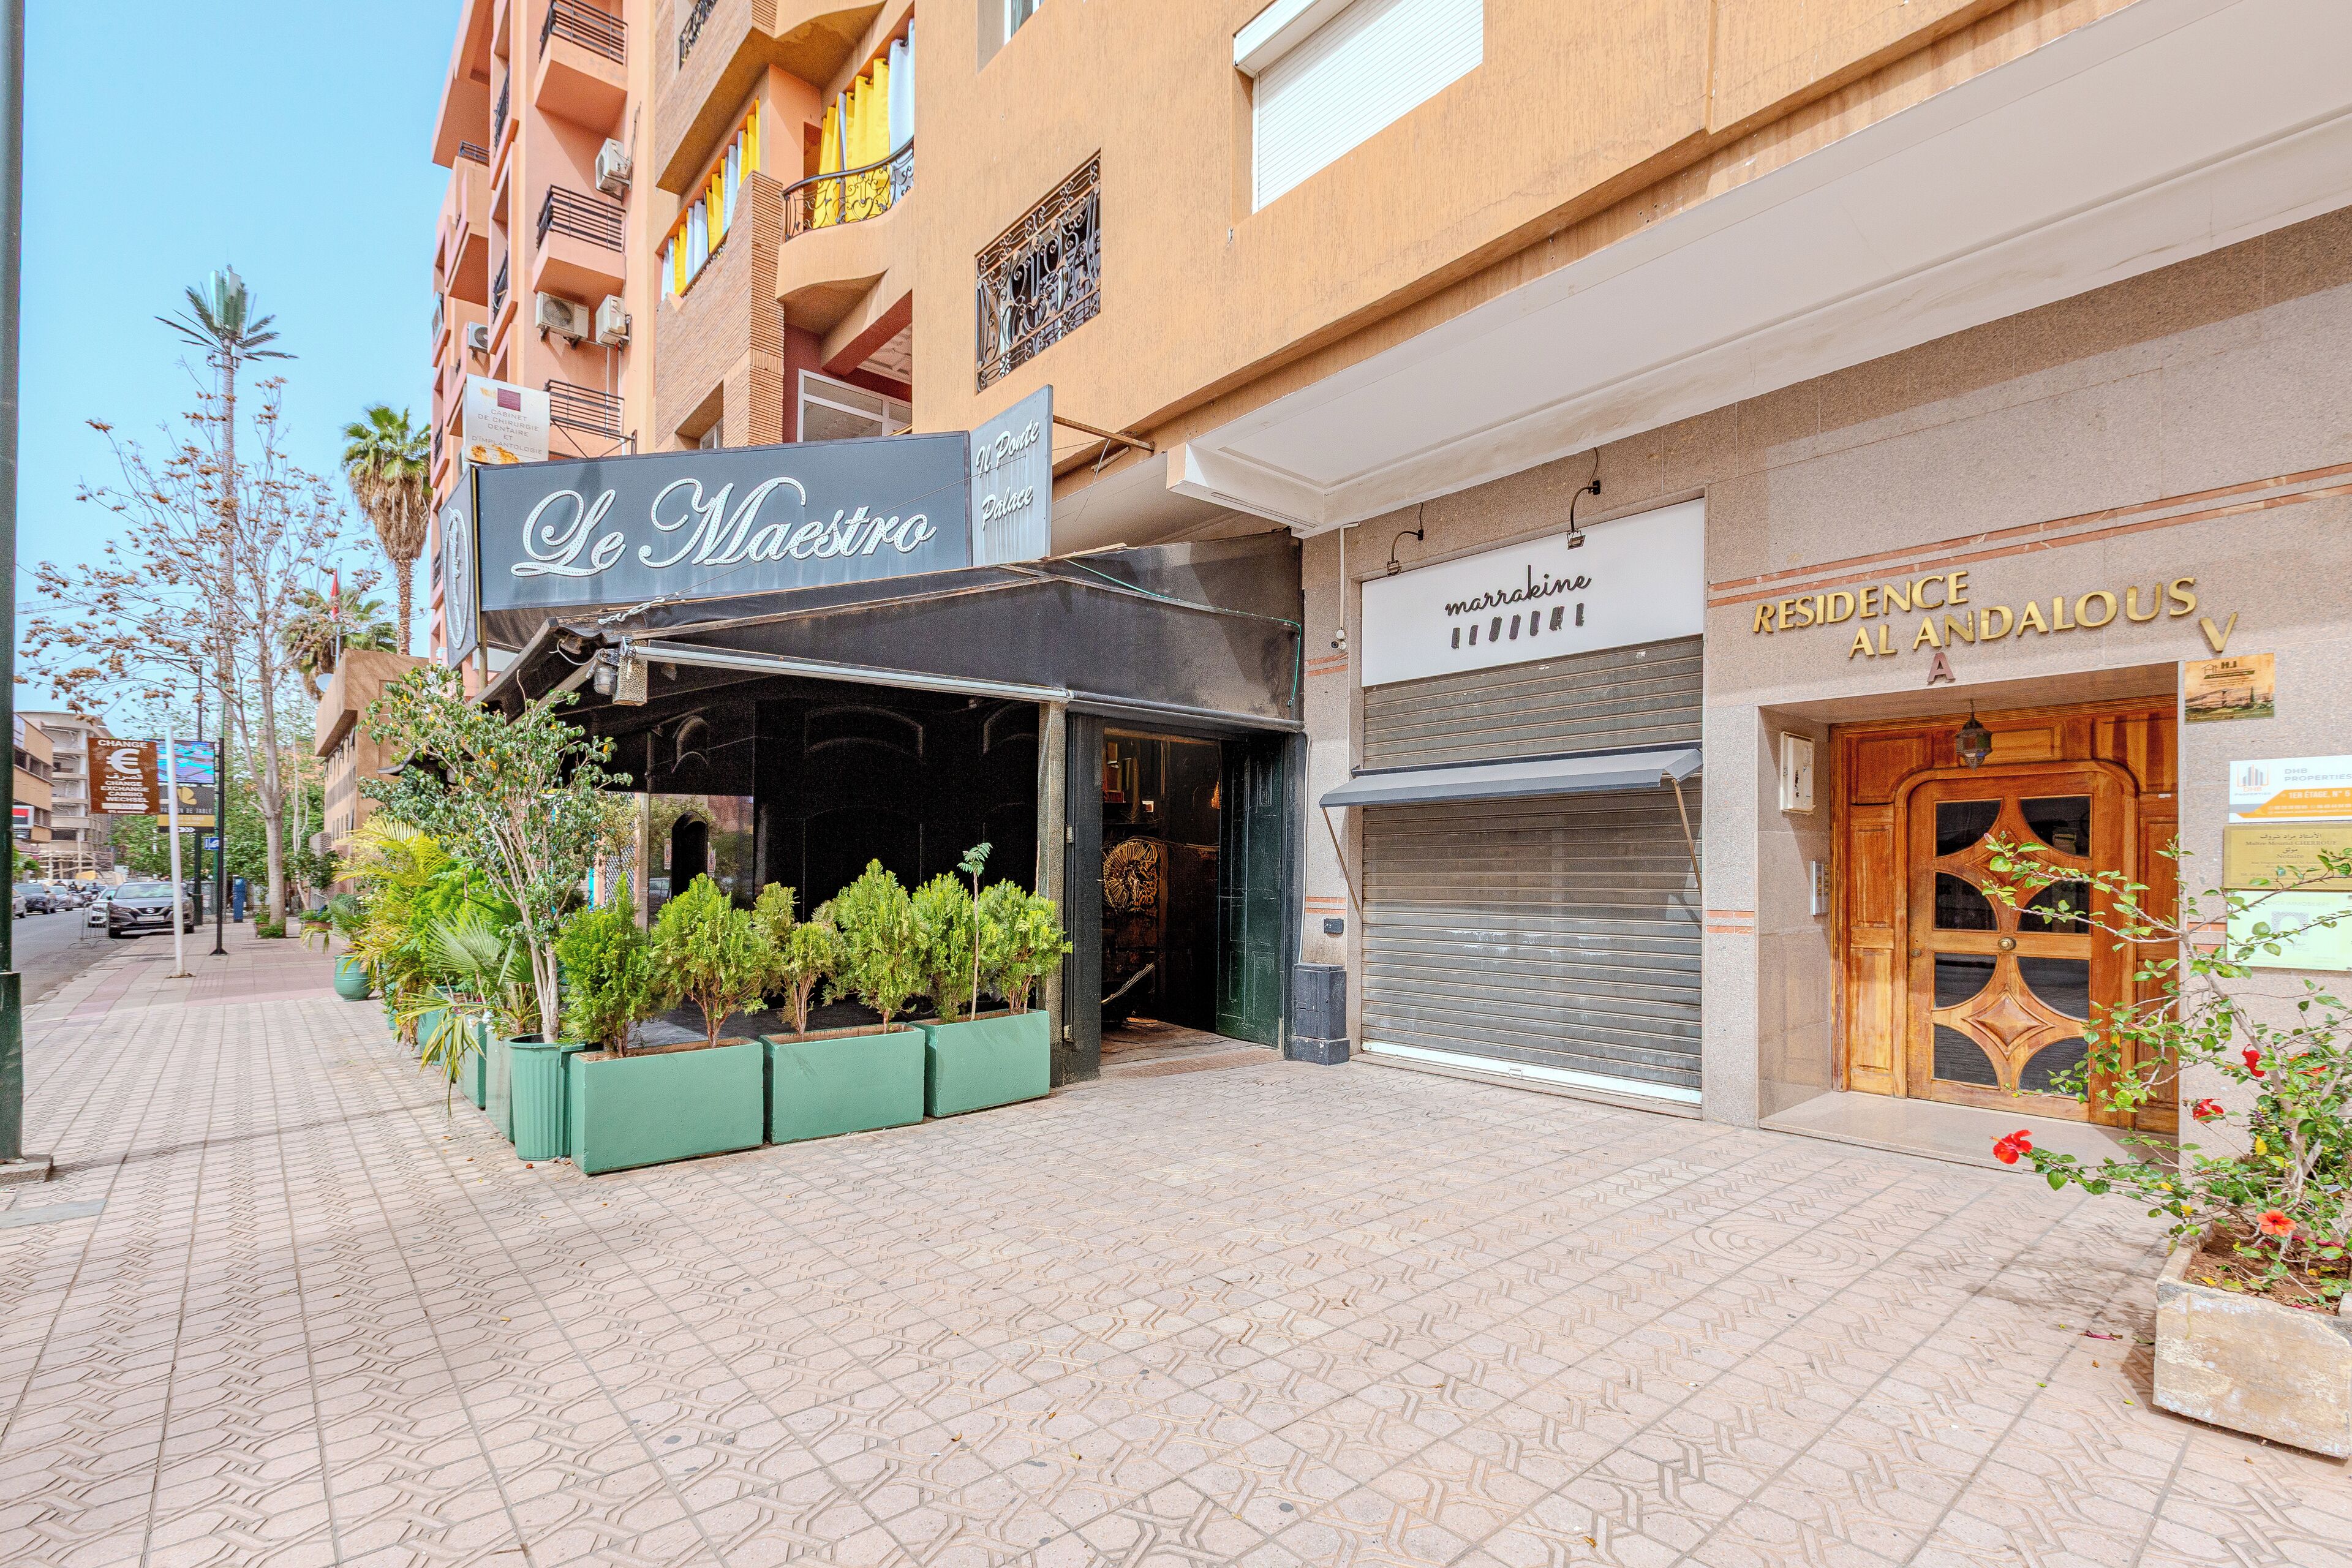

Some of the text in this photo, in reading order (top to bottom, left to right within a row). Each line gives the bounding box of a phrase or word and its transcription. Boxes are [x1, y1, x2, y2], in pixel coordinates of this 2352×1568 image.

[488, 424, 529, 437] DENTAIRE
[491, 409, 527, 421] CABINET
[492, 417, 539, 432] CHIRURGIE
[472, 435, 543, 455] D'IMPLANTOLOGIE
[995, 419, 1040, 470] Ponte
[511, 489, 627, 577] Le
[638, 477, 937, 568] Maestro
[981, 485, 1034, 532] Palace
[1445, 564, 1593, 617] marrakine
[1752, 570, 1969, 633] RESIDENCE
[1849, 577, 2197, 659] AL ANDALOUS
[2199, 612, 2239, 653] V
[1927, 651, 1956, 684] A
[97, 739, 148, 748] CHANGE
